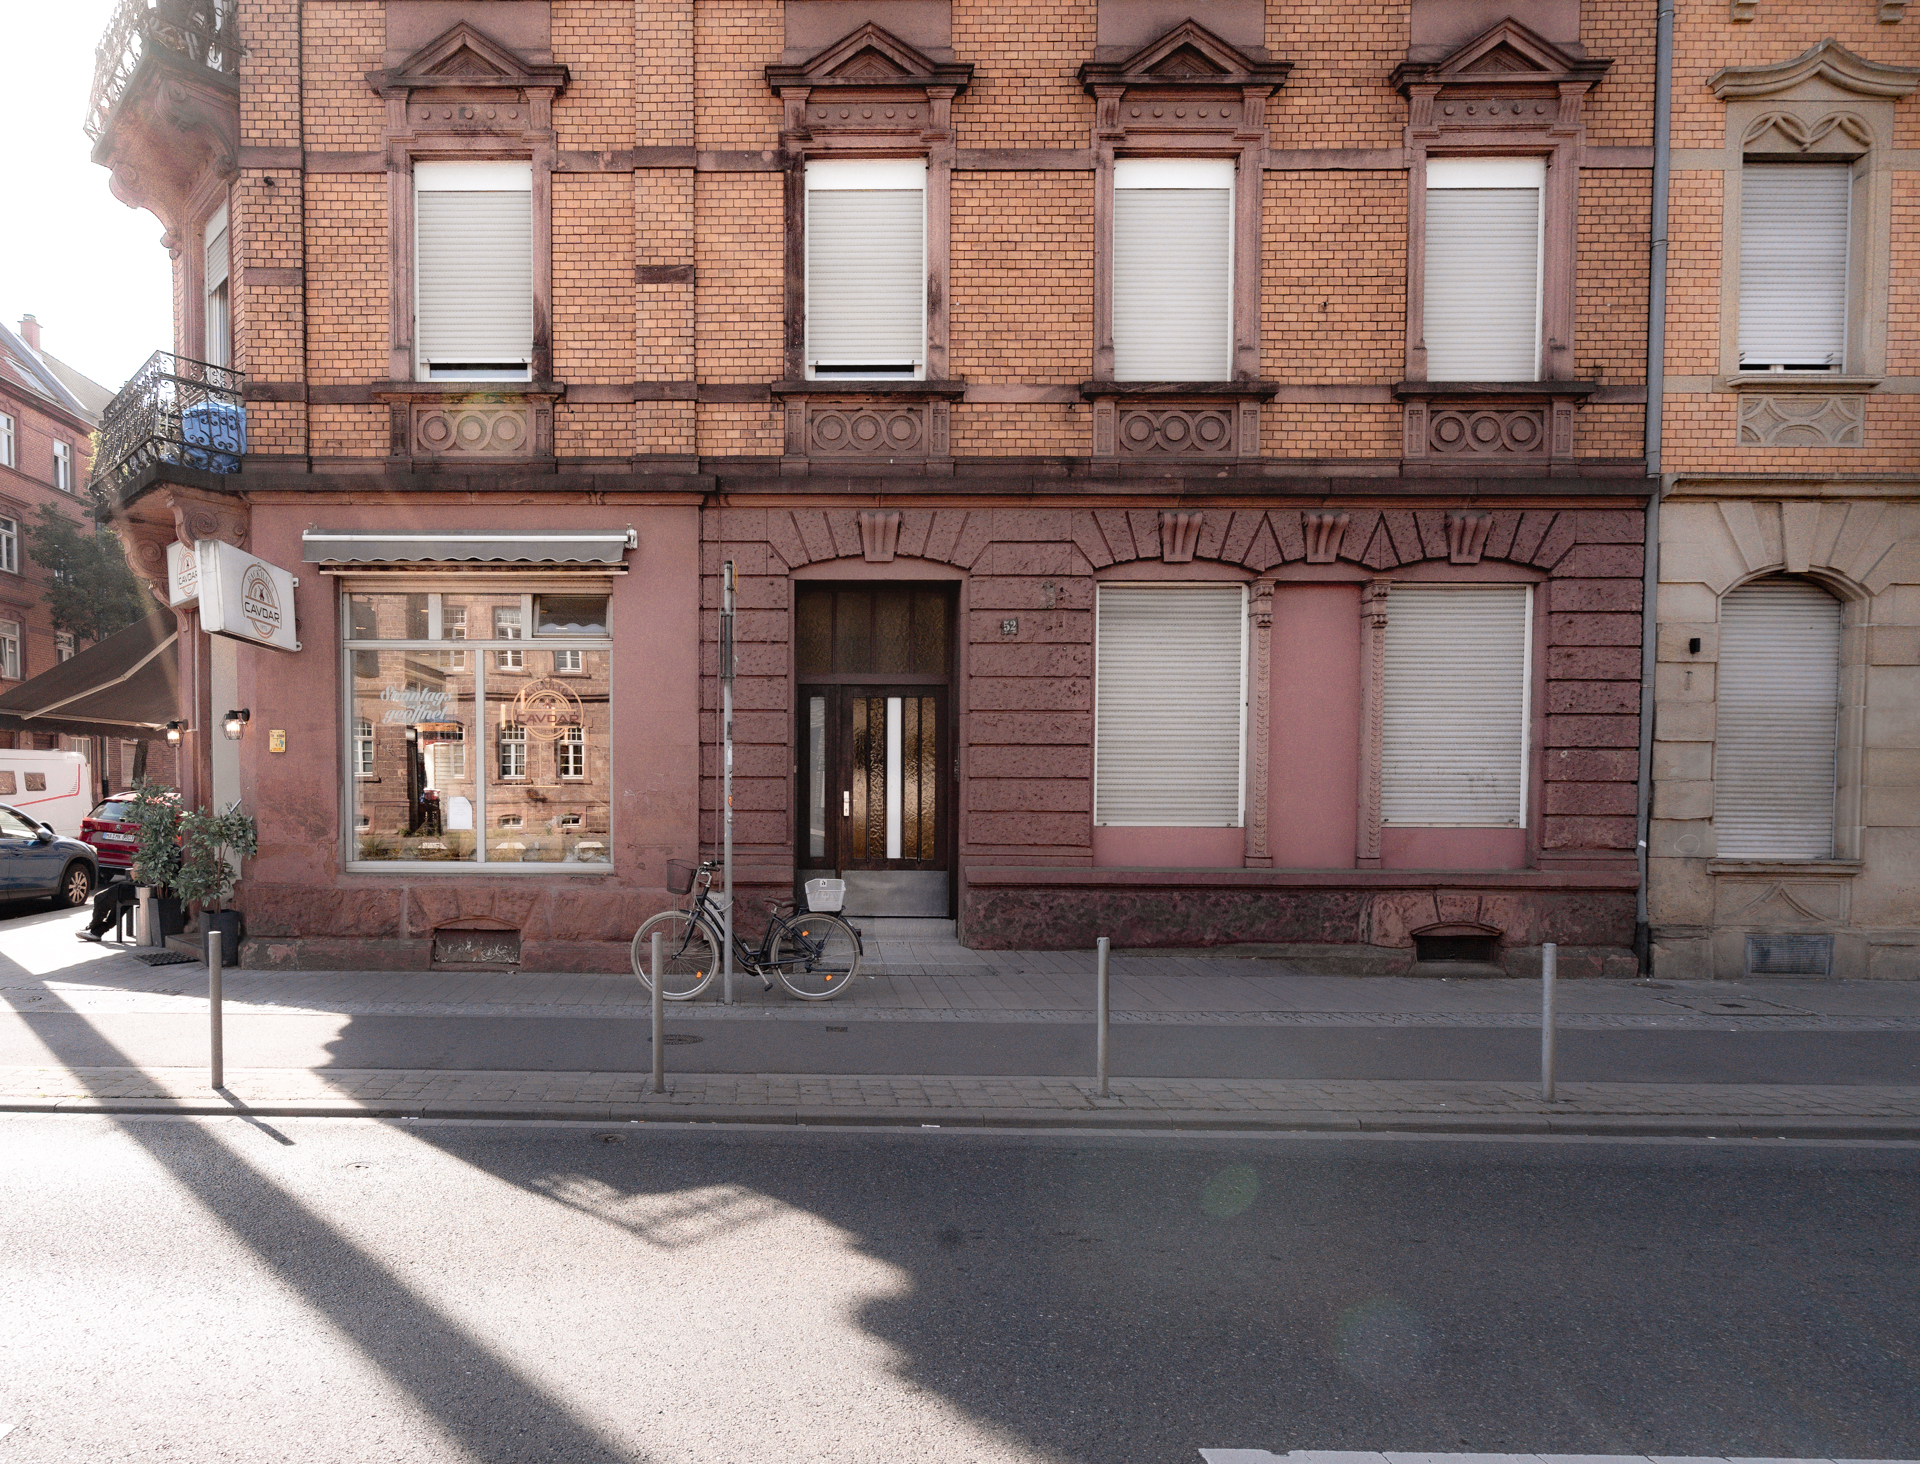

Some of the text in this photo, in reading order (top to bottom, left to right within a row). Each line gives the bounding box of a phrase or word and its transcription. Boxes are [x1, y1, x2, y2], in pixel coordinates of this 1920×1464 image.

[245, 602, 280, 623] CAVDAR
[1003, 620, 1017, 632] 52
[380, 685, 452, 706] Sonntags
[382, 704, 449, 724] geöffnet
[516, 714, 580, 723] CAVDAR
